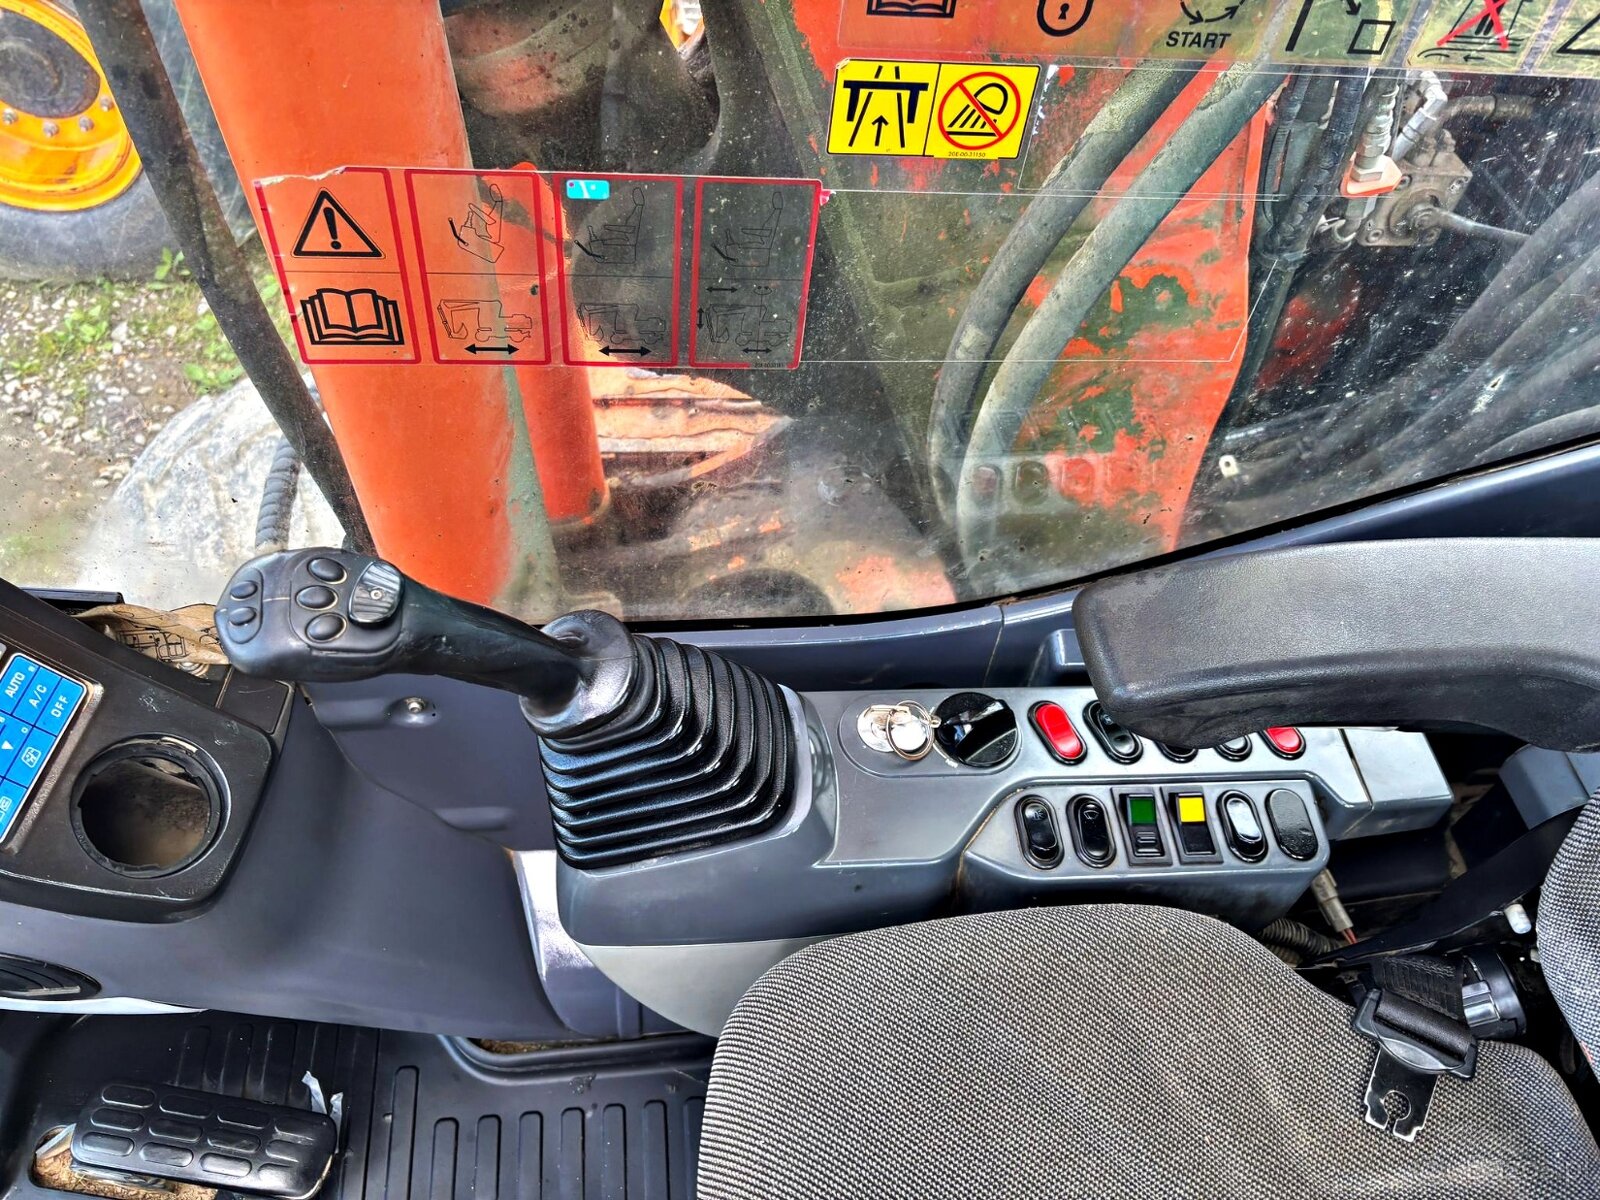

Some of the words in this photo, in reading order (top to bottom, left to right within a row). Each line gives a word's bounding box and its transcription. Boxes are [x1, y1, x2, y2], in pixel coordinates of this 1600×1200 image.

[1166, 31, 1232, 49] START
[4, 671, 26, 699] AUTO
[28, 684, 47, 709] A/C
[50, 695, 69, 718] OFF
